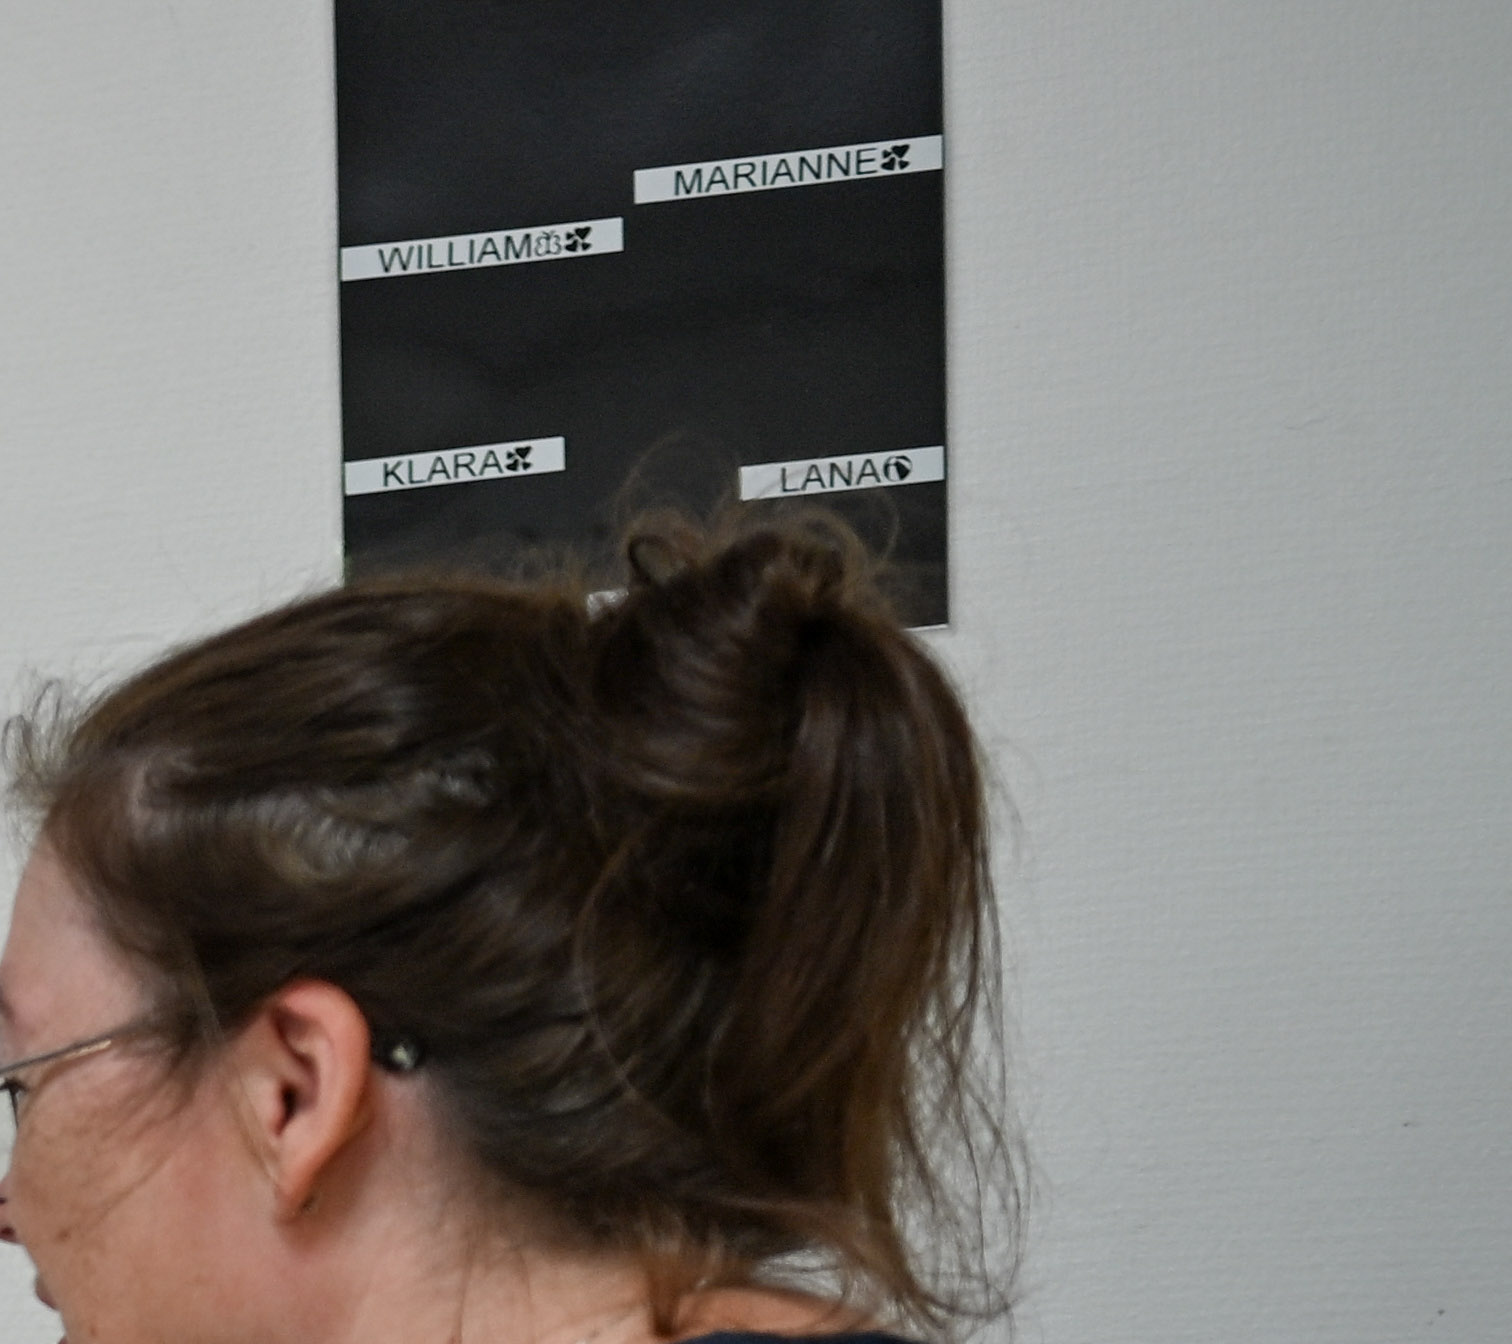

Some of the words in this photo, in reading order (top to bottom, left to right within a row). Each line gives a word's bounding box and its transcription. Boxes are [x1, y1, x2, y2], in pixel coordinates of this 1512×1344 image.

[672, 147, 879, 196] MARIANNE
[378, 233, 533, 273] WILLIAM
[382, 450, 504, 487] KLARA
[780, 459, 881, 492] LANA
